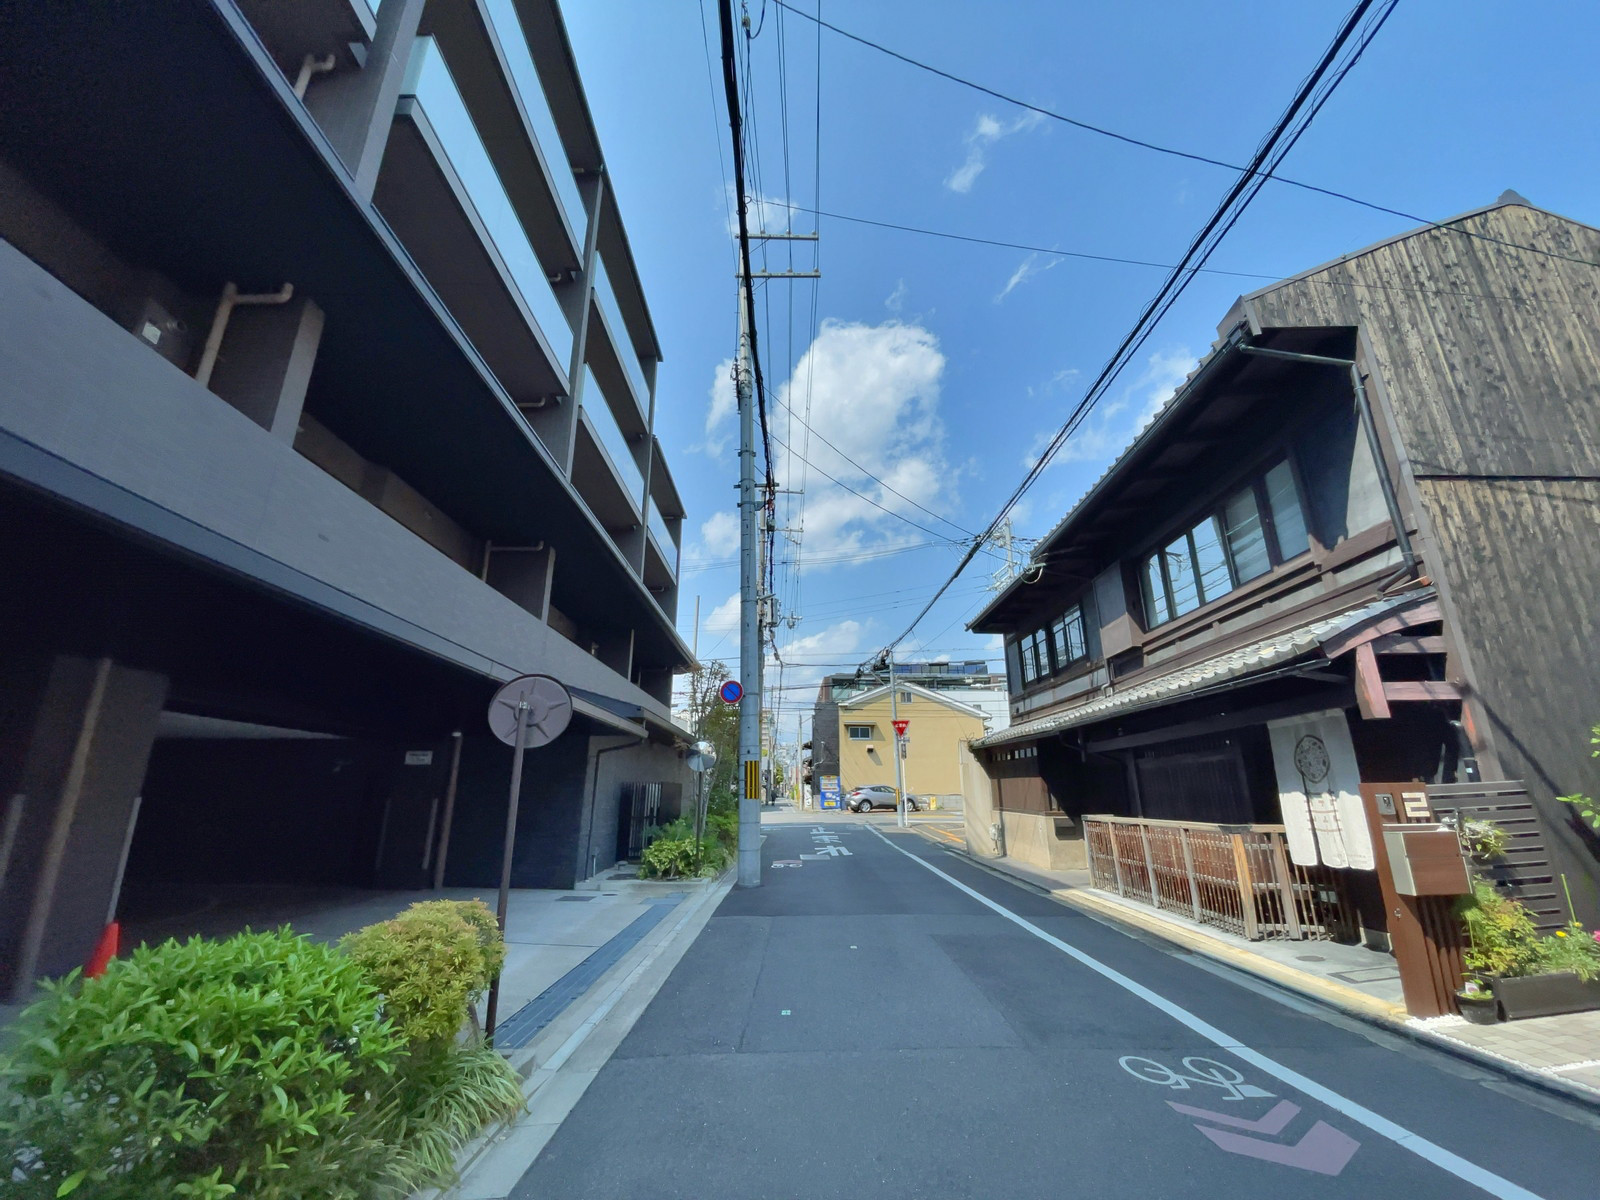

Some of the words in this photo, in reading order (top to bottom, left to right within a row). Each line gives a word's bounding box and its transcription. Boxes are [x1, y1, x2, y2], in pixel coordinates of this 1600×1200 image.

[1401, 792, 1431, 817] 2
[810, 826, 853, 856] 止まれ
